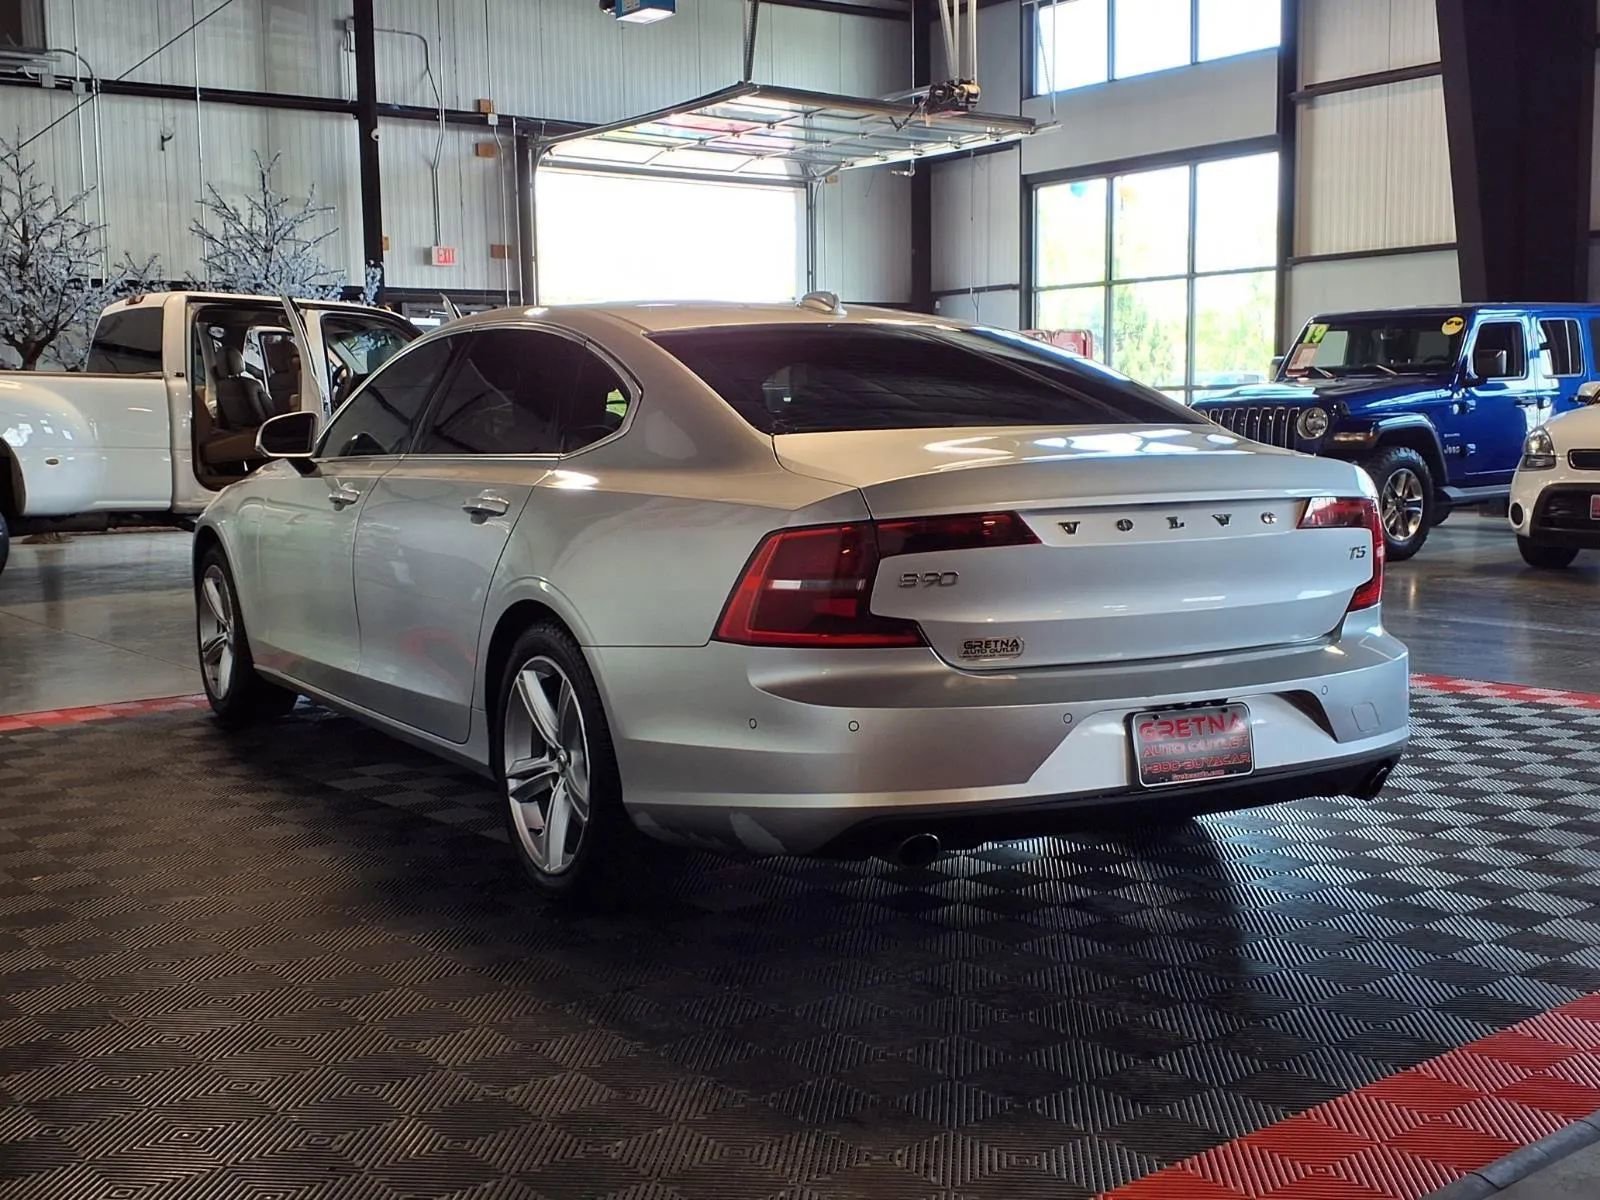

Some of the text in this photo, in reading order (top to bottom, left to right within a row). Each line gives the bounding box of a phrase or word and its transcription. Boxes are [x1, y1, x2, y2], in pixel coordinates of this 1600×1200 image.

[437, 248, 455, 263] EXIT
[1303, 324, 1329, 343] 19
[1443, 444, 1460, 454] Jeep
[1058, 511, 1278, 535] VOLVO
[1349, 545, 1366, 560] T5
[899, 571, 959, 588] S90
[963, 638, 1020, 650] GRETNA
[988, 646, 1019, 654] OUTLET
[1139, 712, 1246, 741] GRETNA
[1143, 736, 1249, 758] AUTO OUTLET
